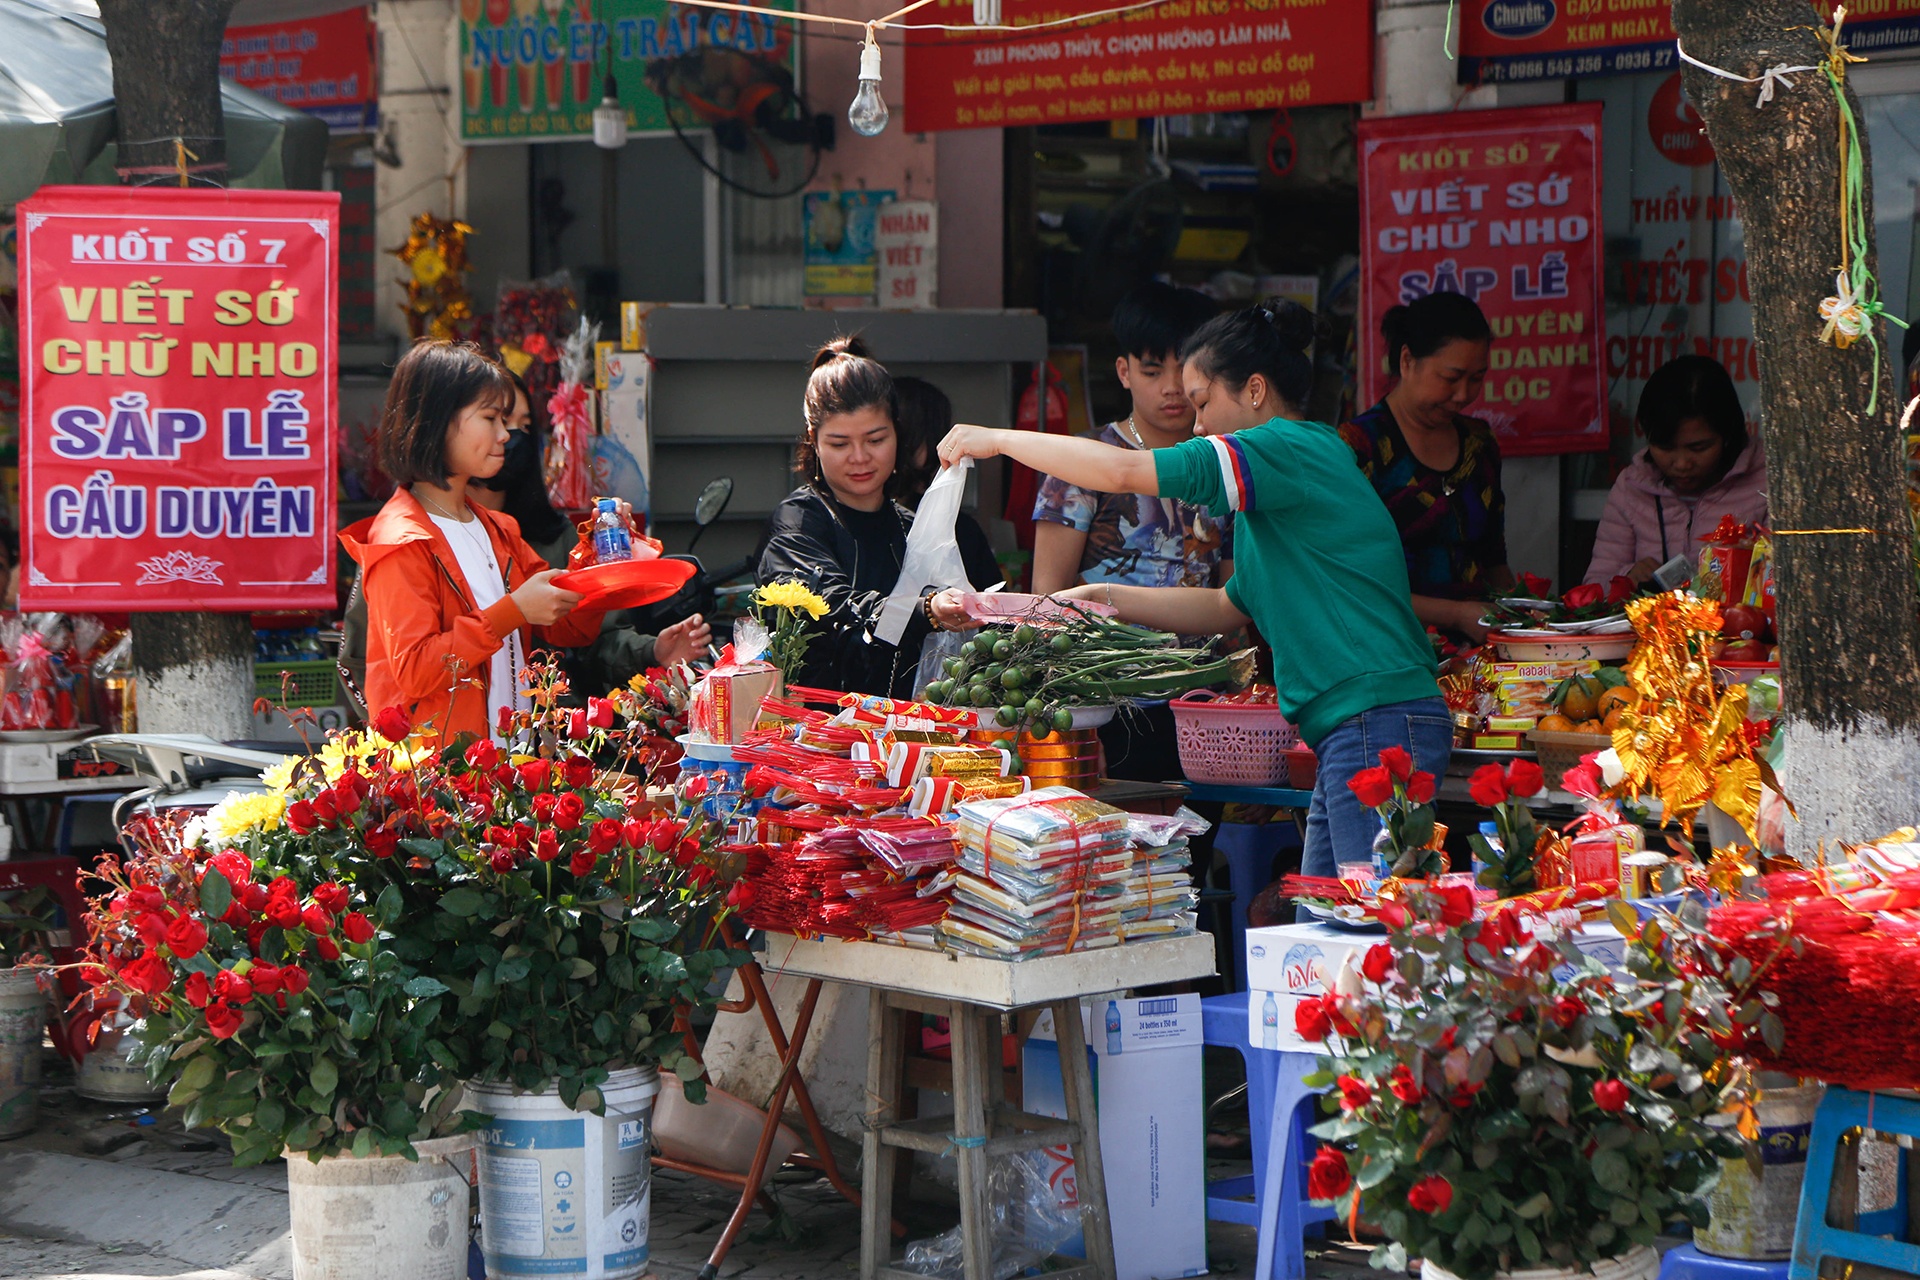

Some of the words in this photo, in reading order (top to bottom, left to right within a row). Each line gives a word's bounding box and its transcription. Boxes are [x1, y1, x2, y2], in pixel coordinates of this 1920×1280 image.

[1493, 1, 1546, 27] Chuyên:
[1567, 27, 1605, 43] XEM
[1611, 17, 1664, 39] NGÀY,
[974, 47, 1004, 67] XEM
[1007, 43, 1062, 64] PHONG
[1107, 33, 1153, 58] CHỌN
[1157, 26, 1216, 51] HƯỚNG
[1219, 22, 1252, 46] LÀM
[1256, 17, 1292, 43] NHÀ
[1654, 48, 1673, 67] 27
[1205, 89, 1241, 107] Xem
[1398, 143, 1474, 172] KIỐT
[1484, 136, 1531, 166] SỐ
[1540, 142, 1562, 163] 7
[1390, 177, 1490, 216] VIẾT
[1506, 172, 1573, 209] SỚ
[71, 227, 174, 262] KIỐT
[187, 229, 249, 264] SỐ
[259, 239, 287, 264] 7
[1378, 216, 1480, 253] CHỮ
[1489, 215, 1589, 248] NHO
[1512, 250, 1569, 302] LỄ
[1620, 238, 1709, 305] VIẾT
[58, 276, 195, 326] VIẾT
[213, 280, 300, 327] SỚ
[1490, 308, 1584, 339] UYÊN
[42, 332, 179, 378] CHỮ
[191, 341, 318, 378] NHO
[1489, 344, 1590, 371] DANH
[1484, 374, 1551, 406] LỘC
[50, 391, 207, 461] SẮP
[222, 389, 312, 461] LỄ
[44, 469, 148, 540] CẦU
[155, 476, 316, 539] DUYÊN
[1519, 665, 1551, 677] nabati
[1145, 1020, 1160, 1030] bottles
